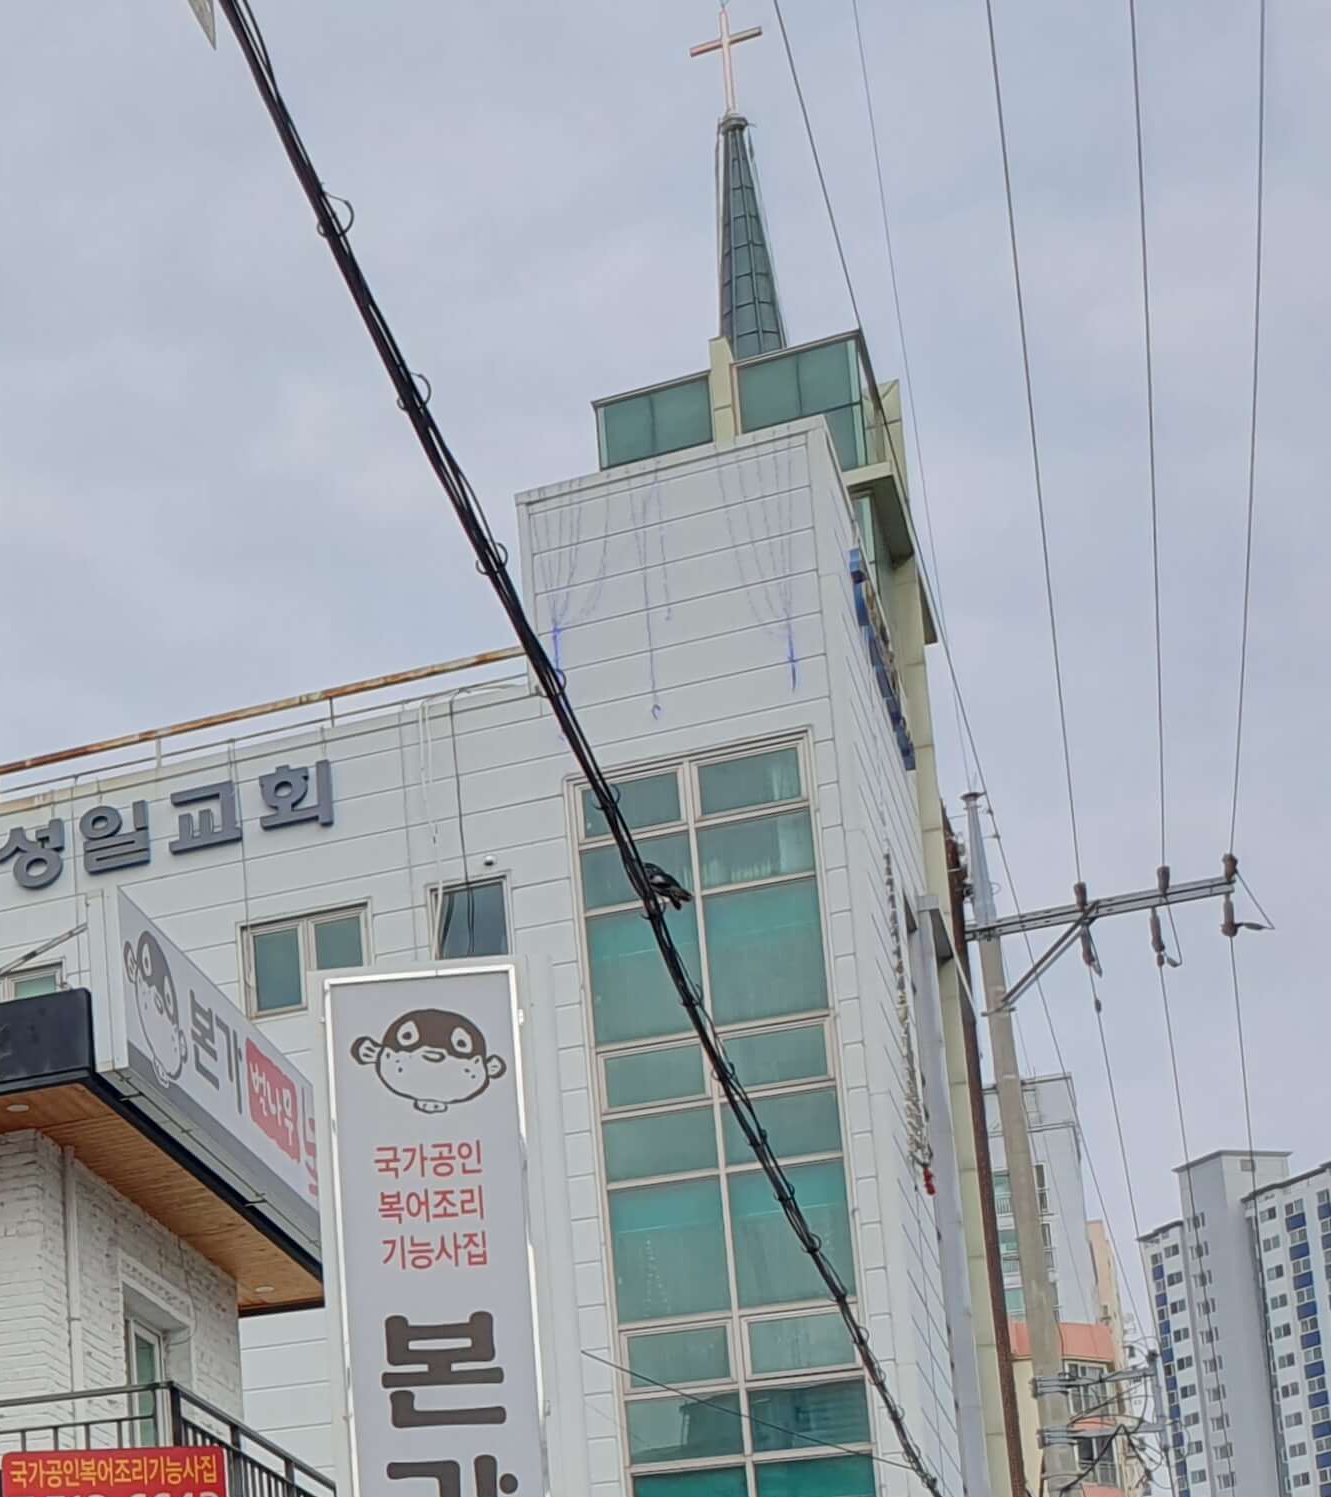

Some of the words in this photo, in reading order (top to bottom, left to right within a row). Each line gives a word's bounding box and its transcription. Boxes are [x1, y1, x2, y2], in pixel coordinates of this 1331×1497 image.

[190, 989, 243, 1115] 본가
[374, 1139, 484, 1179] 국가공인
[378, 1185, 485, 1225] 복어조리
[382, 1231, 488, 1270] 기능사집
[10, 1455, 218, 1489] 국가공인복어조리기능사집
